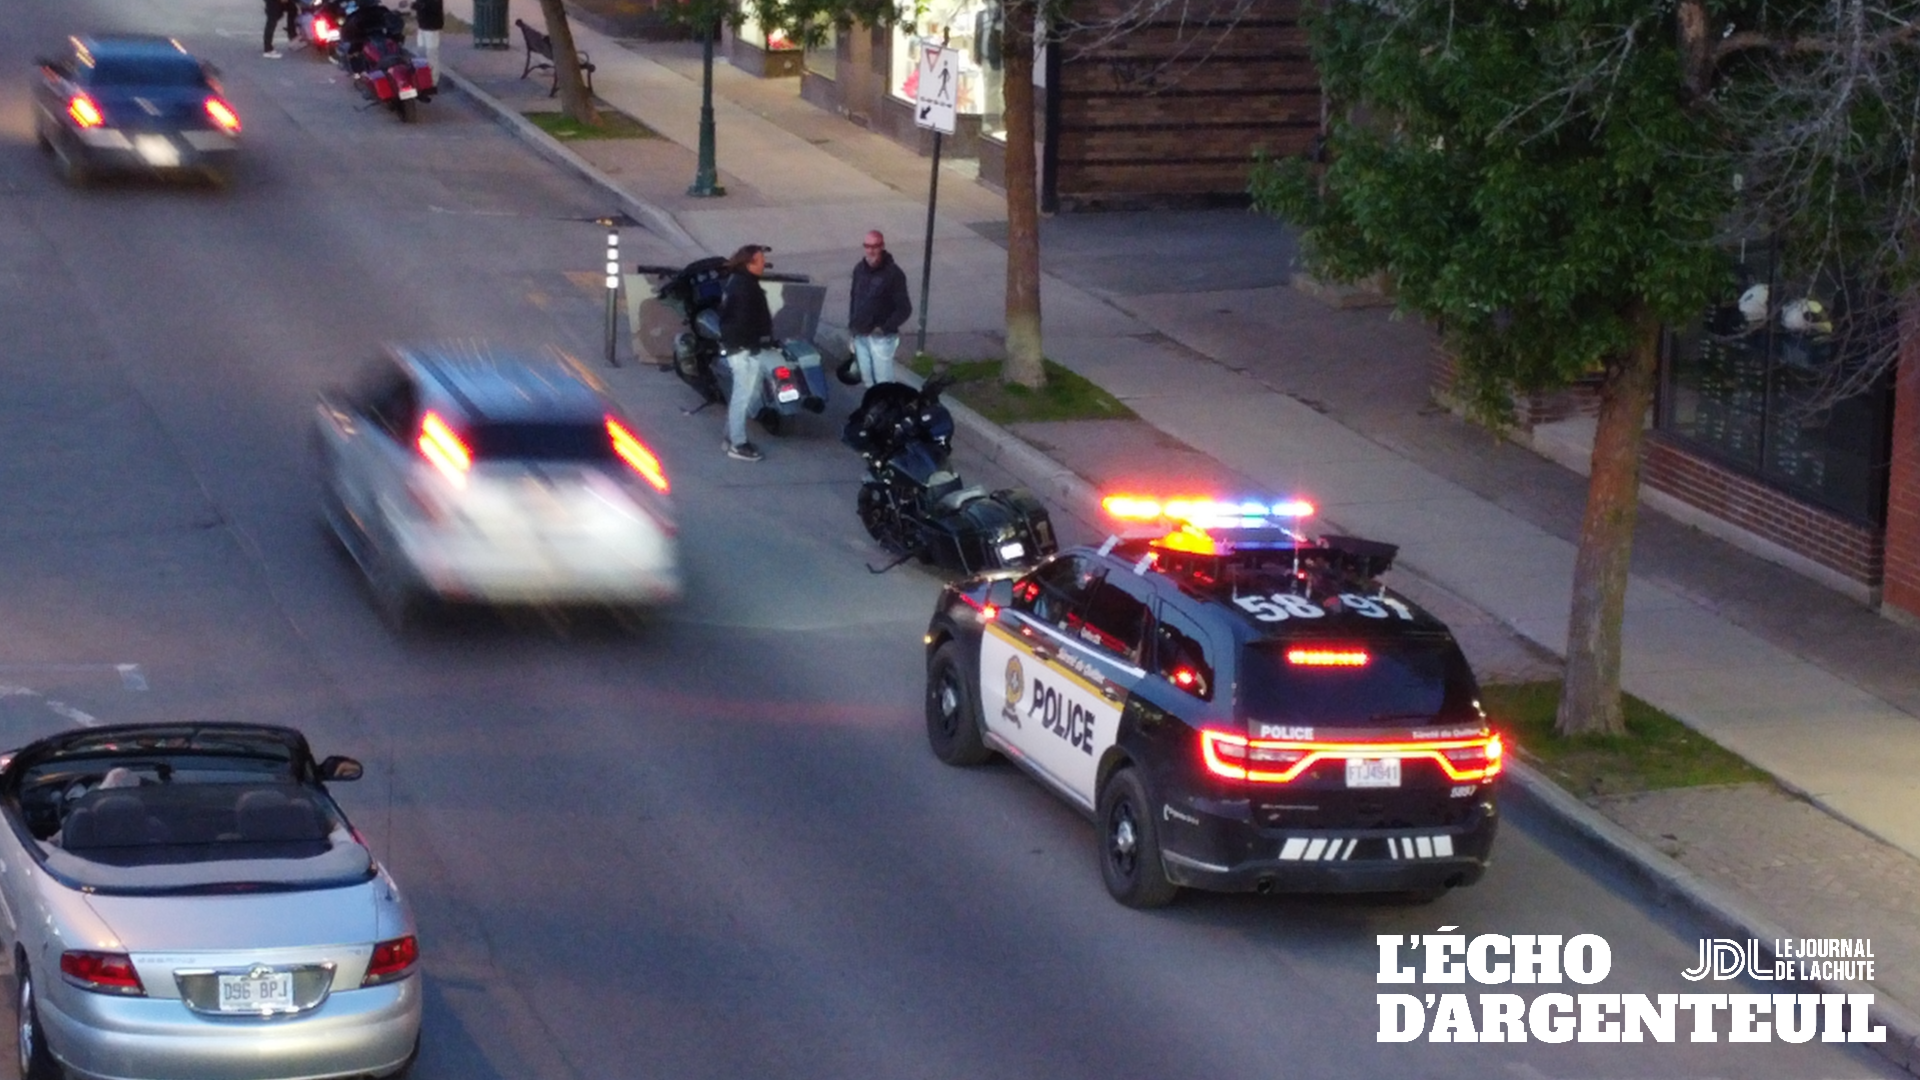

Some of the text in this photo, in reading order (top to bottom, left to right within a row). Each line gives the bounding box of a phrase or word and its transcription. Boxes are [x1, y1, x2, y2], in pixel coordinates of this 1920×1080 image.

[1233, 593, 1414, 621] 58 97
[1027, 677, 1096, 756] POLICE
[1260, 724, 1315, 741] POLICE
[223, 981, 287, 1000] D96 BPJ
